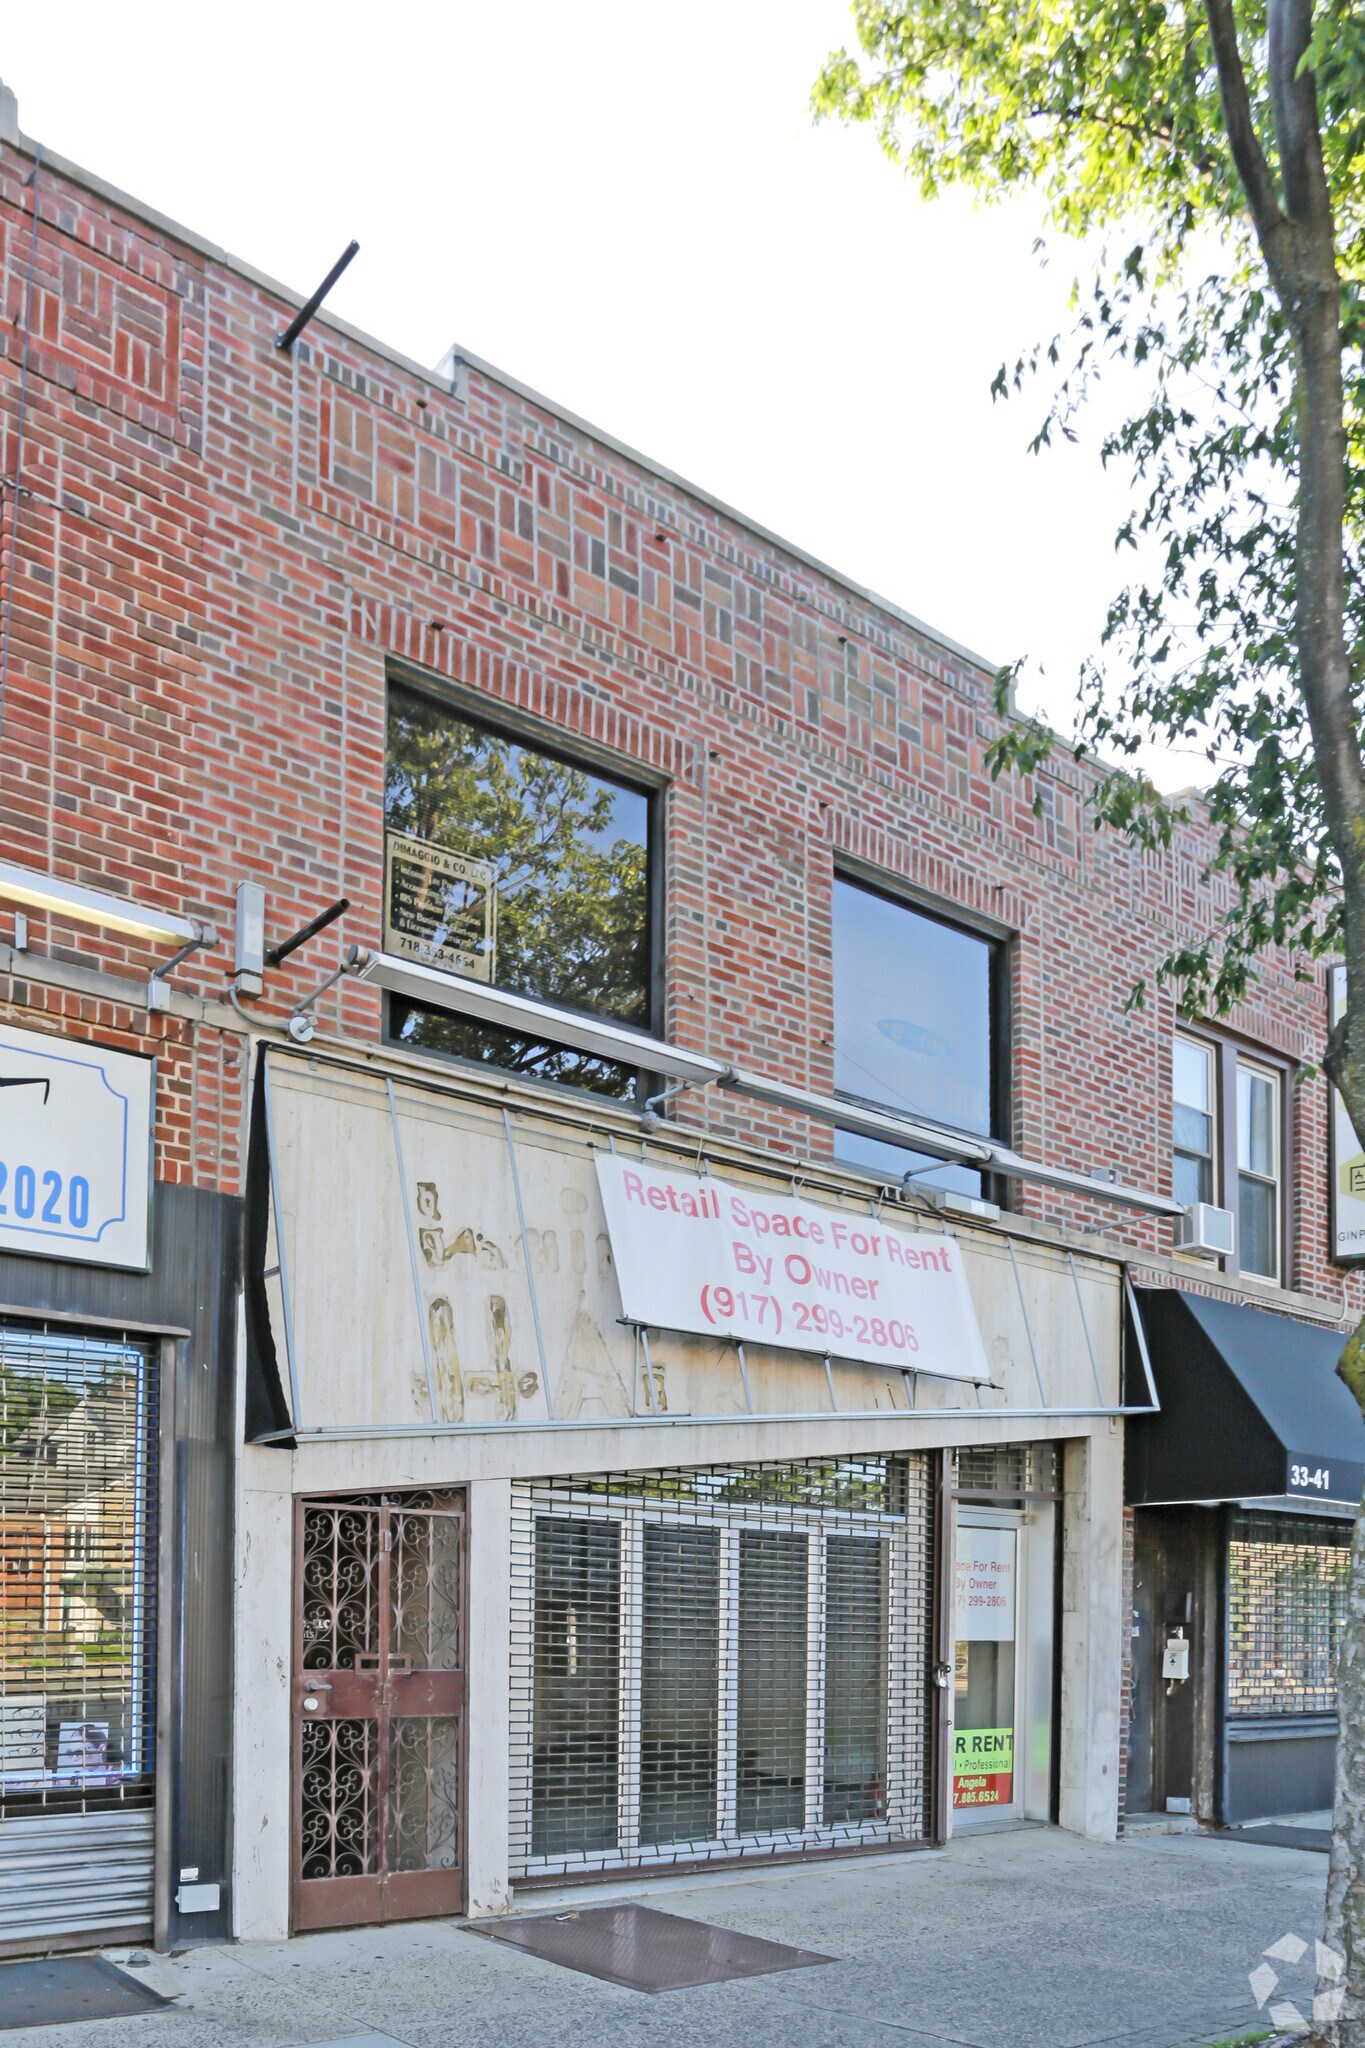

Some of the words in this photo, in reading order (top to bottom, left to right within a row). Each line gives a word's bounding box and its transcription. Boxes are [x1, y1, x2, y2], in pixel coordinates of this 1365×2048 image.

[443, 858, 451, 870] &
[623, 1169, 720, 1219] Retail
[731, 1196, 825, 1245] Space
[831, 1222, 881, 1257] For
[886, 1235, 952, 1273] Rent
[732, 1241, 773, 1285] By
[784, 1254, 879, 1300] Owner
[700, 1284, 782, 1335] (917)
[792, 1302, 919, 1352] 299-2806
[1290, 1464, 1329, 1490] 33-41
[973, 1560, 988, 1572] For
[990, 1561, 1011, 1573] Rent
[969, 1577, 997, 1590] Owner
[972, 1735, 1014, 1753] RENT
[964, 1758, 1011, 1770] Professional
[958, 1776, 987, 1790] Angela
